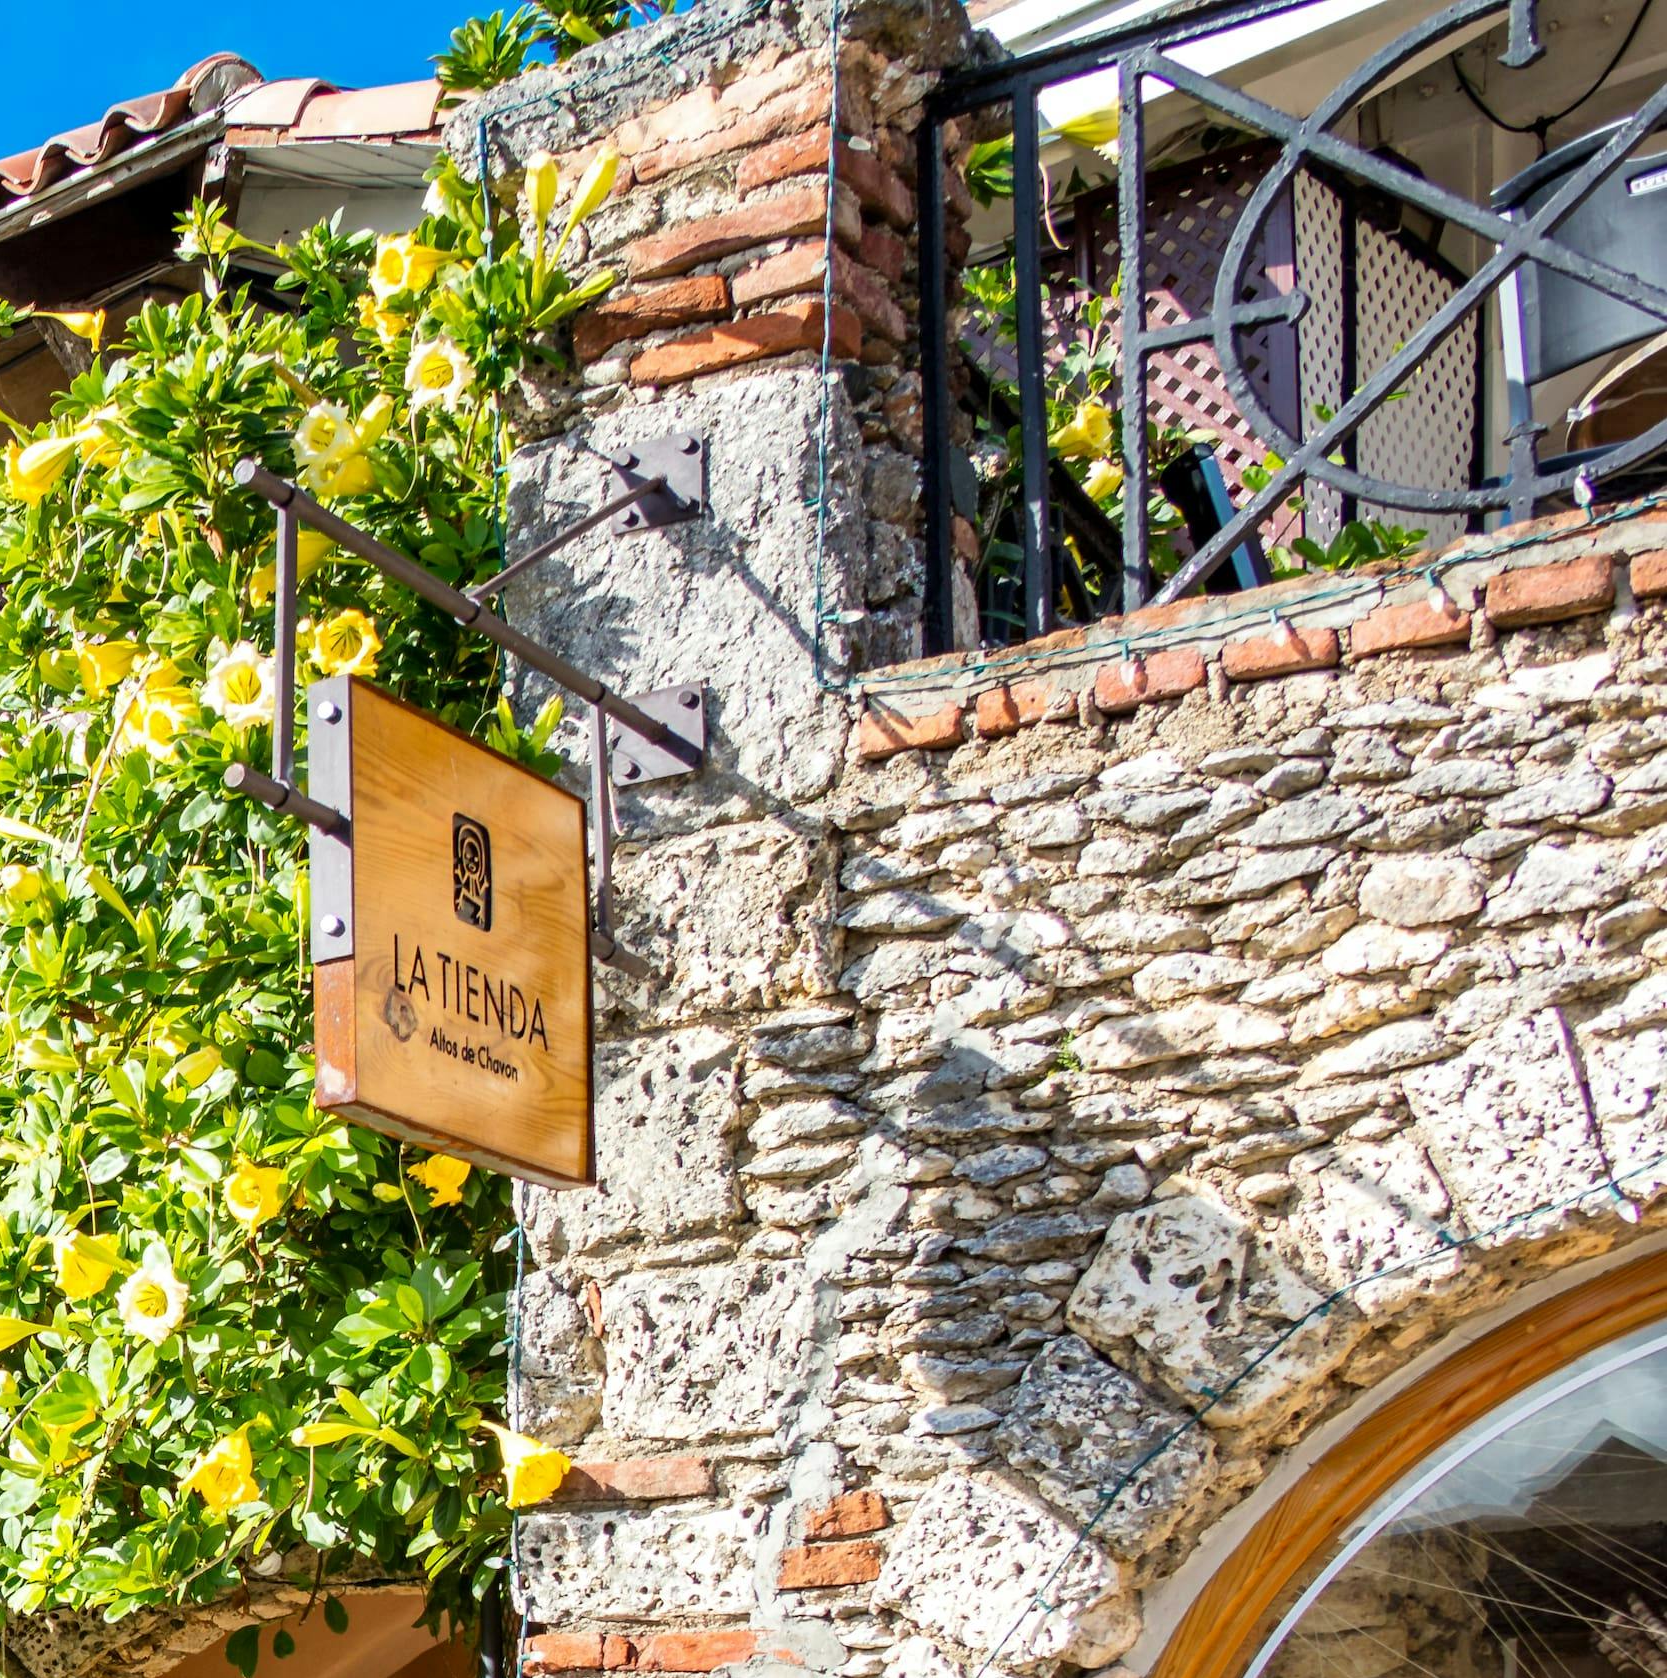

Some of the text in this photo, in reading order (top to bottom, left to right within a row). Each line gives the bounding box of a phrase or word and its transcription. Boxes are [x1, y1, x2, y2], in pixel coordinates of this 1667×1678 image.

[393, 933, 549, 1053] LA TIENDA
[429, 1026, 519, 1083] Altos de Chavon
